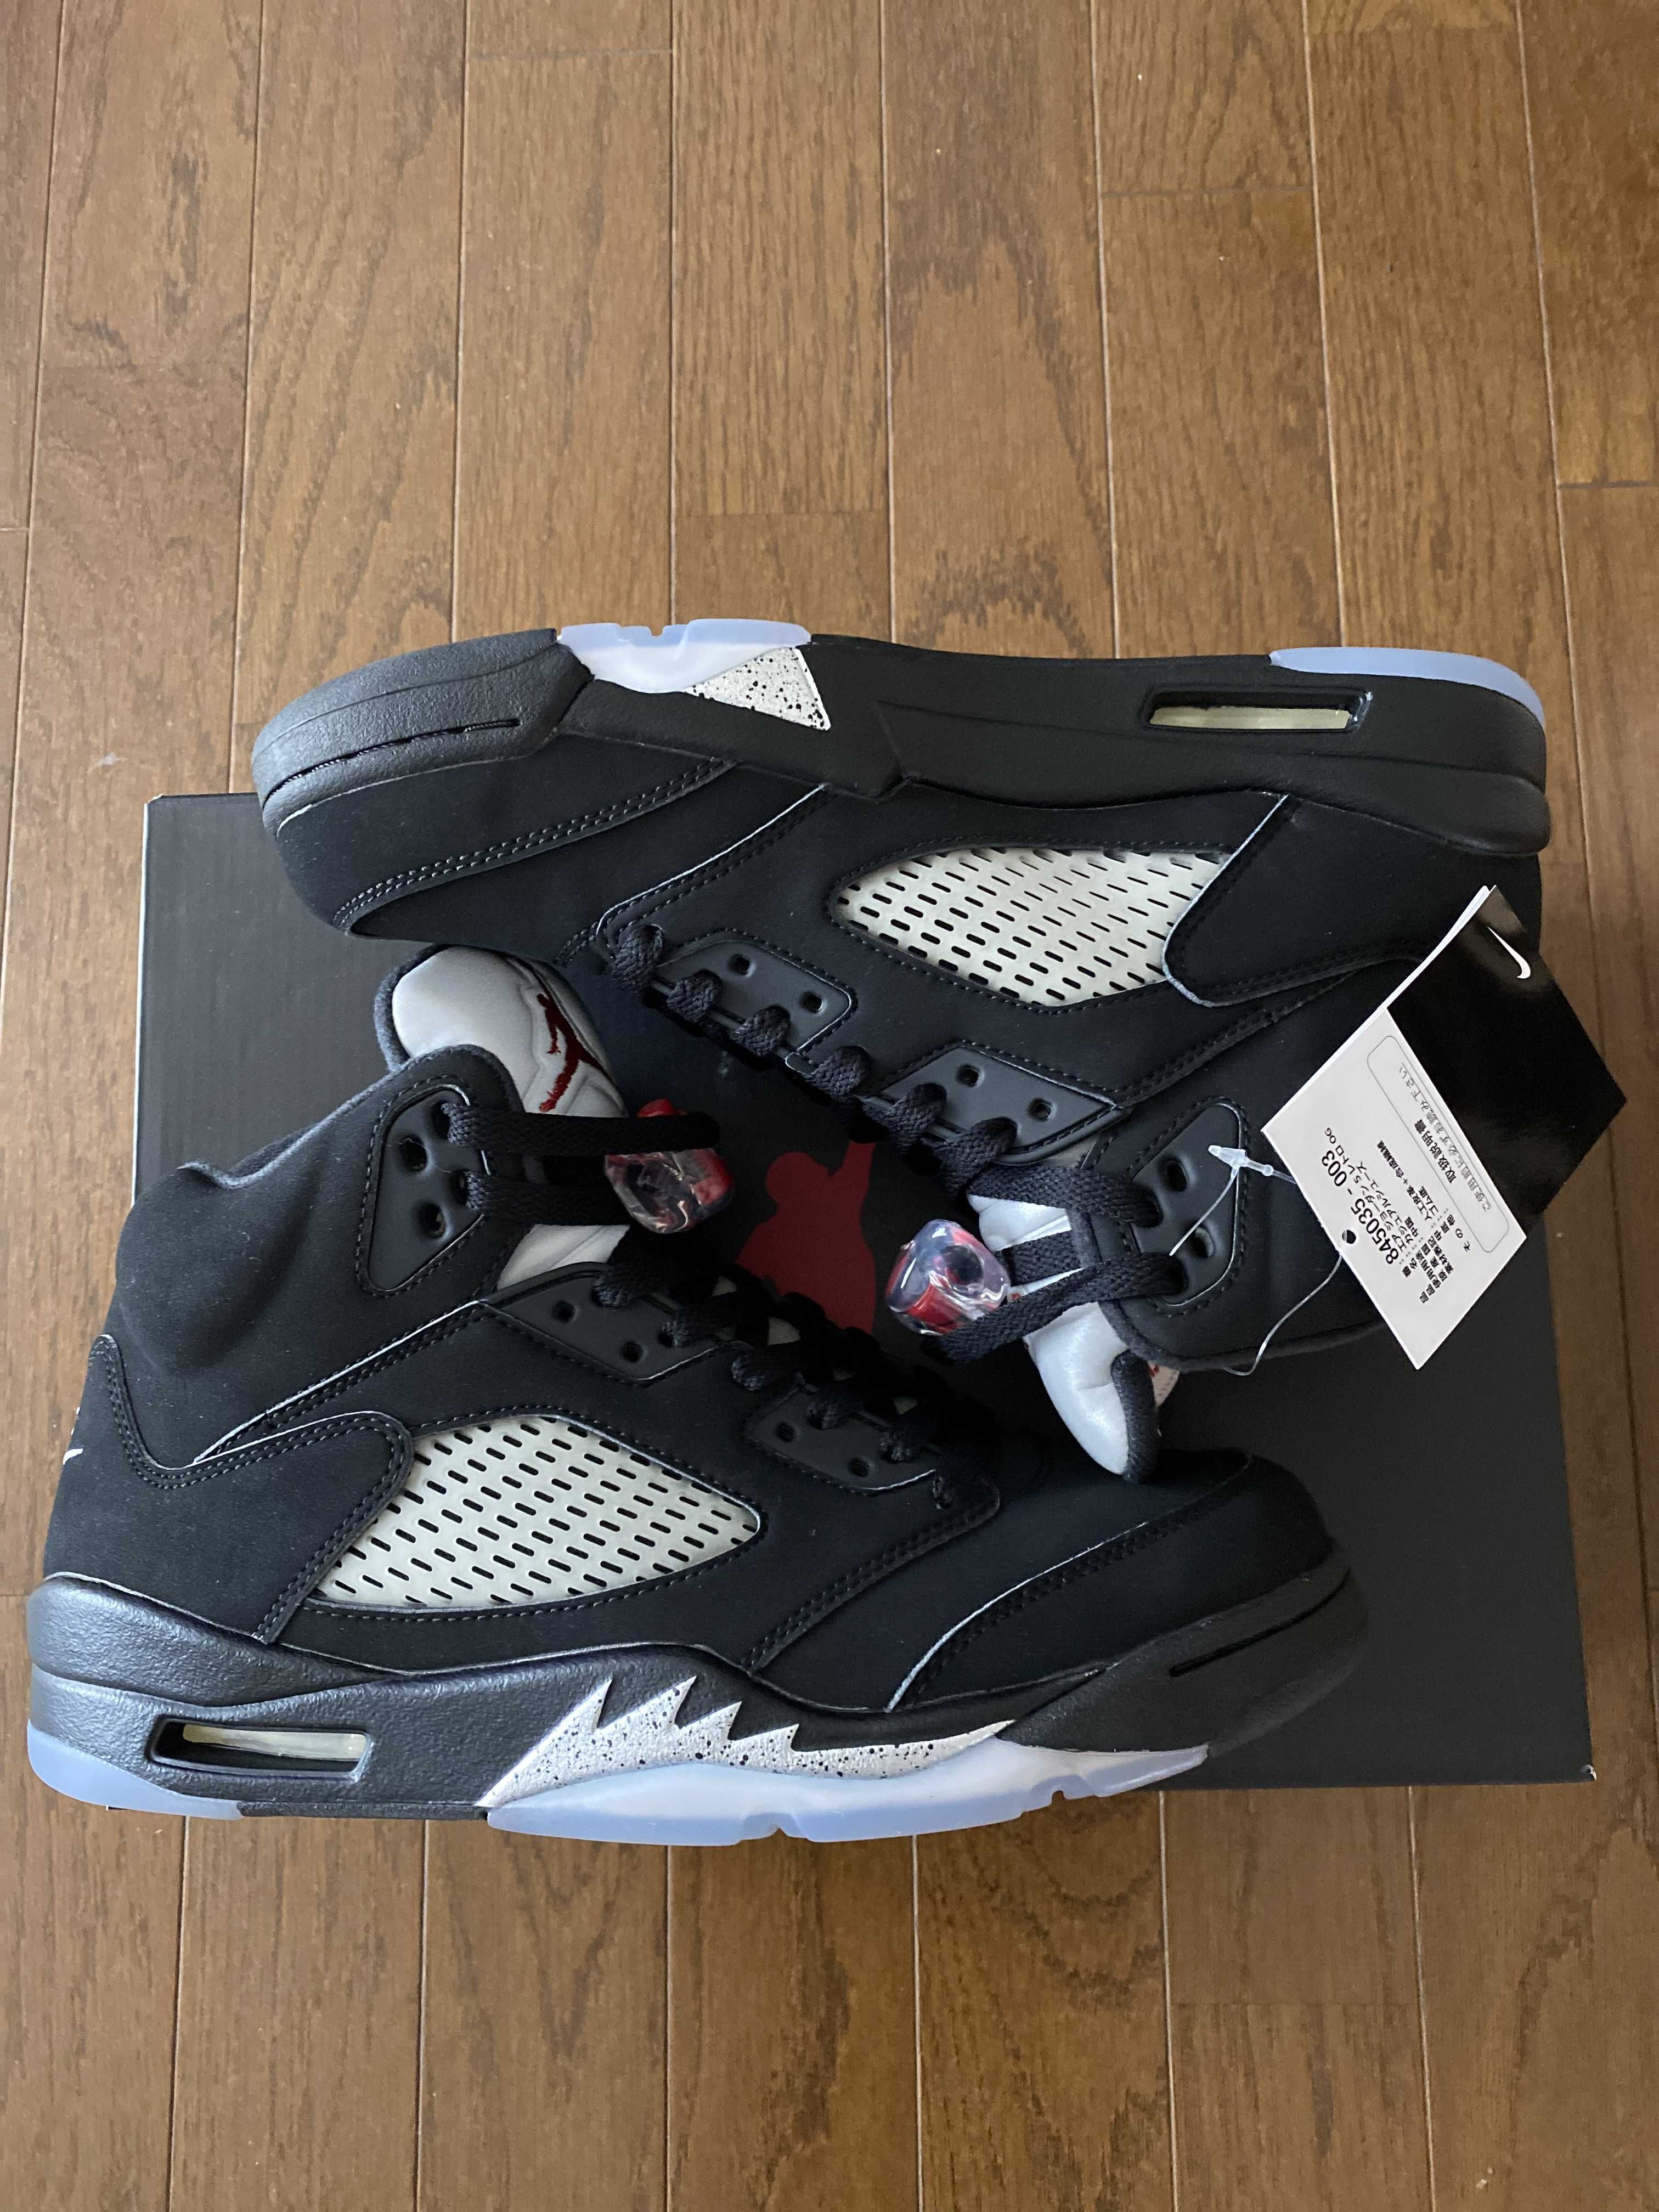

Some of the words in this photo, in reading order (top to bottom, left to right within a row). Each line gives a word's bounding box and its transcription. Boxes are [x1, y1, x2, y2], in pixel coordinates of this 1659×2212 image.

[1324, 1127, 1336, 1144] OG
[1335, 1144, 1355, 1175] レトロ
[1414, 1119, 1456, 1184] 取扱説明書
[1321, 1150, 1347, 1187] 003
[1353, 1175, 1361, 1184] 5
[1361, 1185, 1393, 1231] ジョーダン
[1350, 1198, 1398, 1264] 845035
[1404, 1216, 1418, 1237] 中国
[1391, 1234, 1407, 1252] エア
